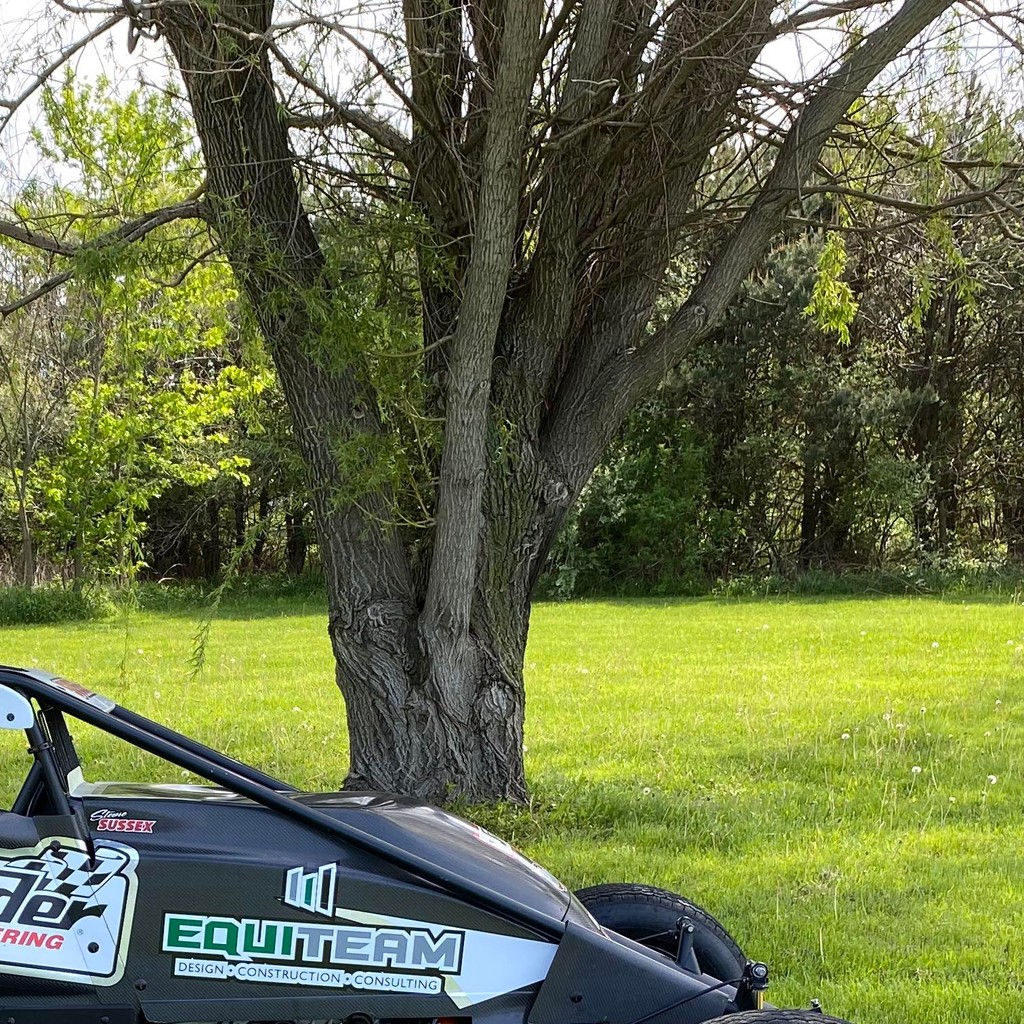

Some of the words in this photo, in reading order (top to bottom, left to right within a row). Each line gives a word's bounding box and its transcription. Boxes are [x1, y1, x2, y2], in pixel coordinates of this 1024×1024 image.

[97, 818, 156, 833] SUSSEX
[166, 917, 460, 969] EQUITEAM
[178, 961, 225, 975] DESIGN
[237, 965, 341, 983] CONSTRUCTION
[353, 973, 439, 992] CONSULTING
